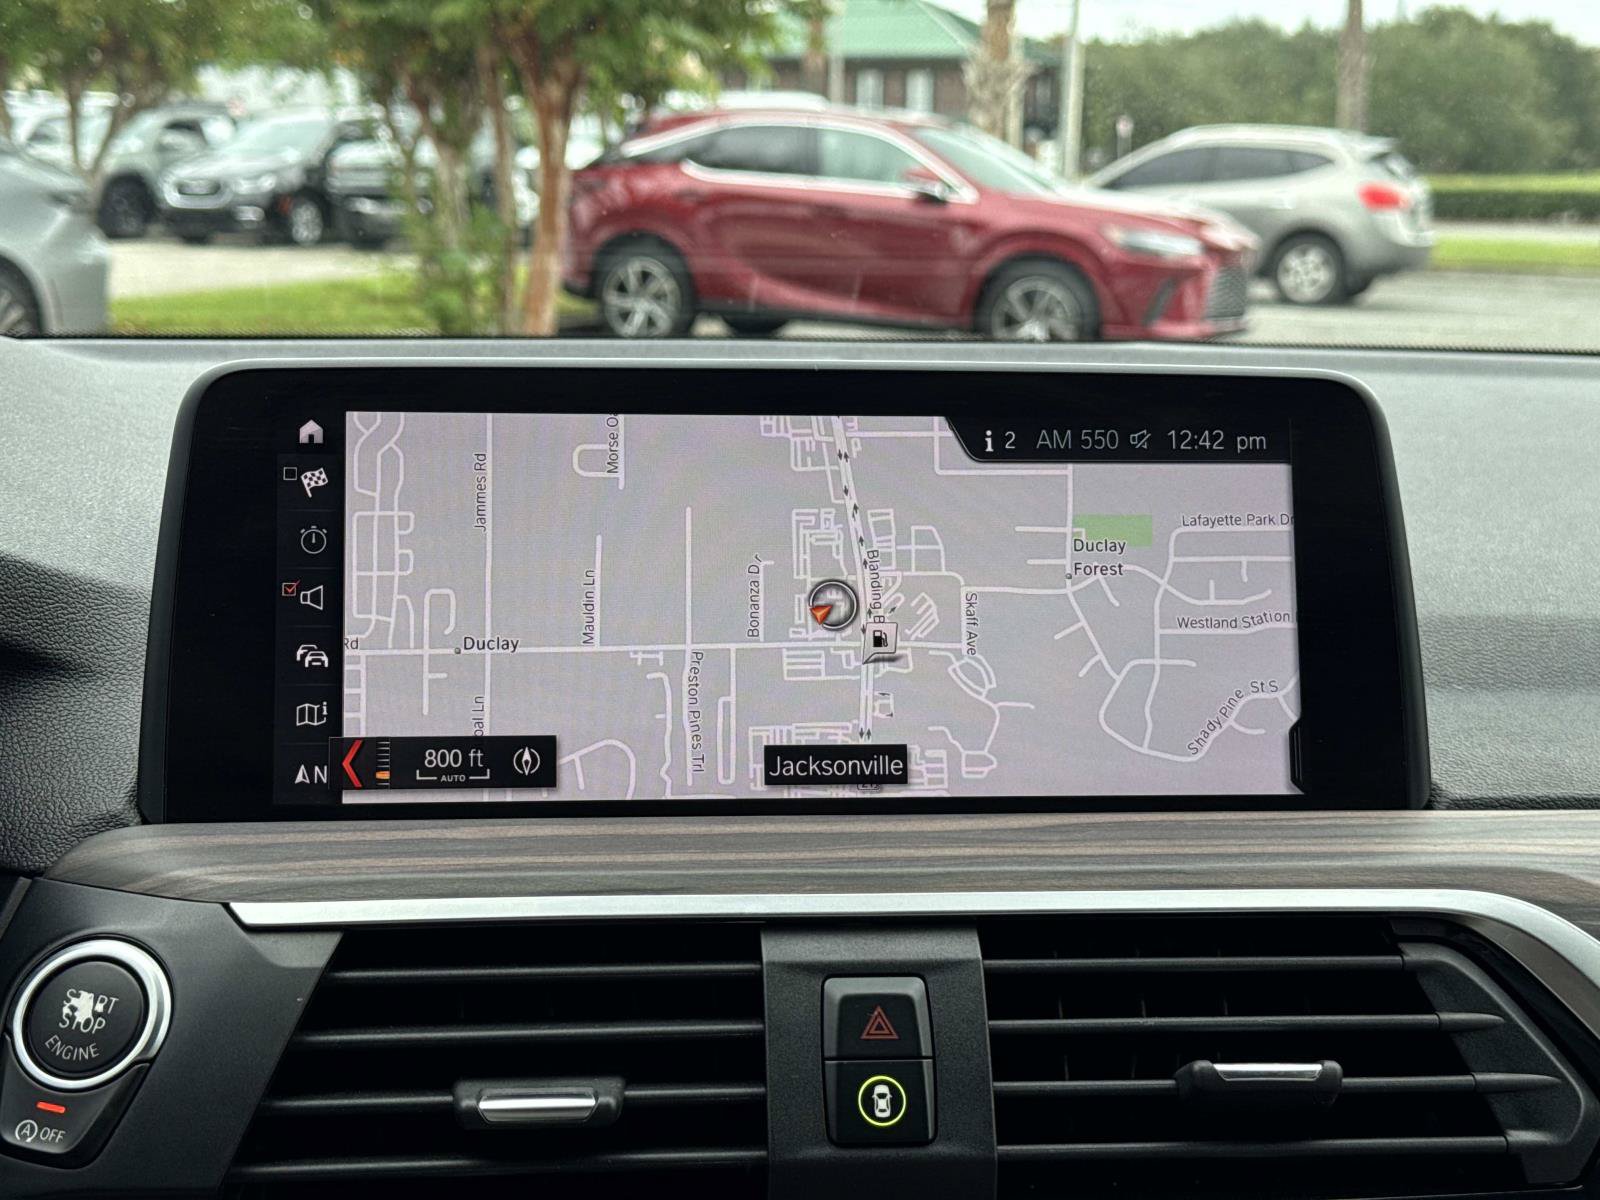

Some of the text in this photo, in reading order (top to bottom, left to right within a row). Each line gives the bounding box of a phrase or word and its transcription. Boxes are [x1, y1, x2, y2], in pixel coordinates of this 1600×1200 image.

[606, 412, 619, 474] Morse O
[1004, 431, 1017, 449] 2
[1036, 429, 1119, 449] AM 550
[1167, 430, 1267, 454] 12:42 pm
[473, 453, 487, 533] Jammes Rd
[1181, 513, 1242, 529] Lafayette
[1246, 513, 1277, 526] Park
[1073, 538, 1127, 555] Duclay
[866, 549, 883, 610] Blanding
[1073, 562, 1124, 577] Forest
[746, 553, 763, 638] Bonanza Dr
[581, 569, 596, 647] Mauldin Ln
[964, 592, 979, 656] Skaff Ave
[1176, 610, 1291, 629] Westland Station
[462, 636, 520, 653] Duclay
[471, 696, 485, 712] Ln
[687, 651, 705, 772] Preston Pines Trl
[1187, 680, 1279, 755] Shady Pine St S
[424, 748, 484, 768] 800 ft
[768, 755, 904, 777] Jacksonville
[314, 765, 328, 784] N
[440, 774, 466, 783] AUTO
[44, 1034, 100, 1061] ENGINE
[39, 1126, 67, 1143] OFF
